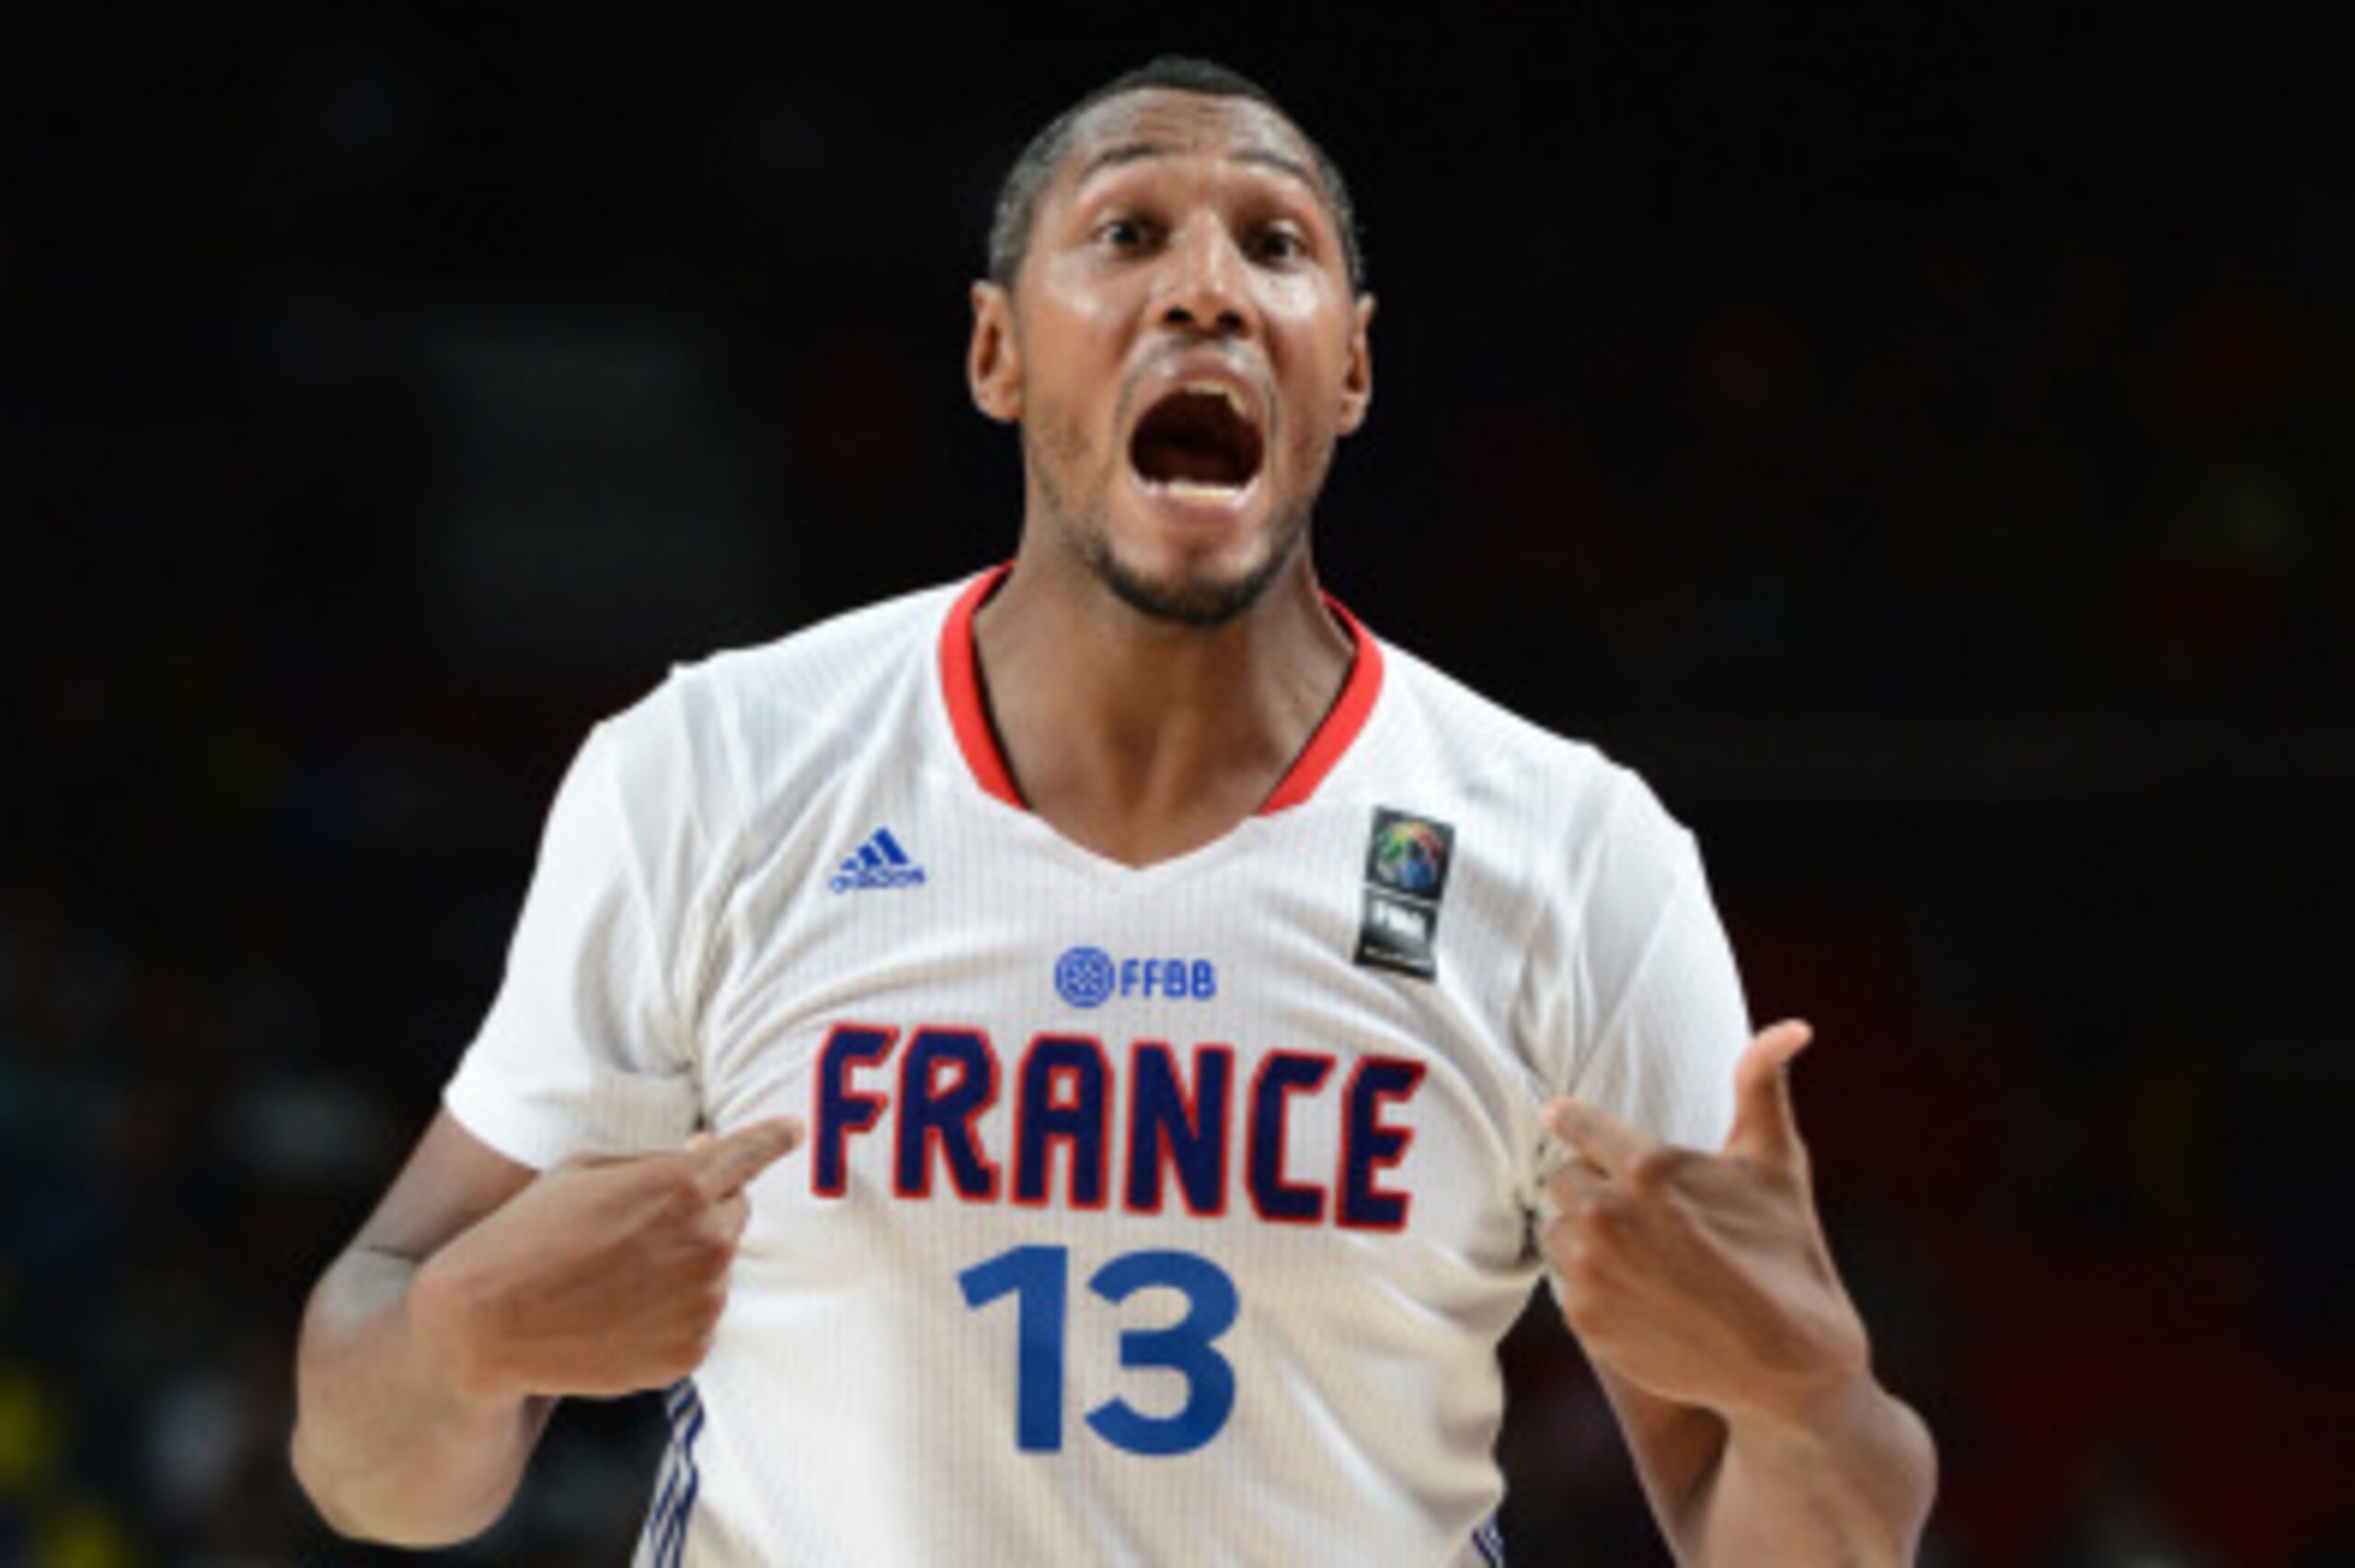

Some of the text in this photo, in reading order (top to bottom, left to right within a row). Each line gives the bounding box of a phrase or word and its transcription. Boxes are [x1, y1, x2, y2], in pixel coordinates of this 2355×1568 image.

[1120, 959, 1216, 999] FFBB
[810, 1023, 1428, 1233] FRANCE
[958, 1245, 1240, 1457] 13
